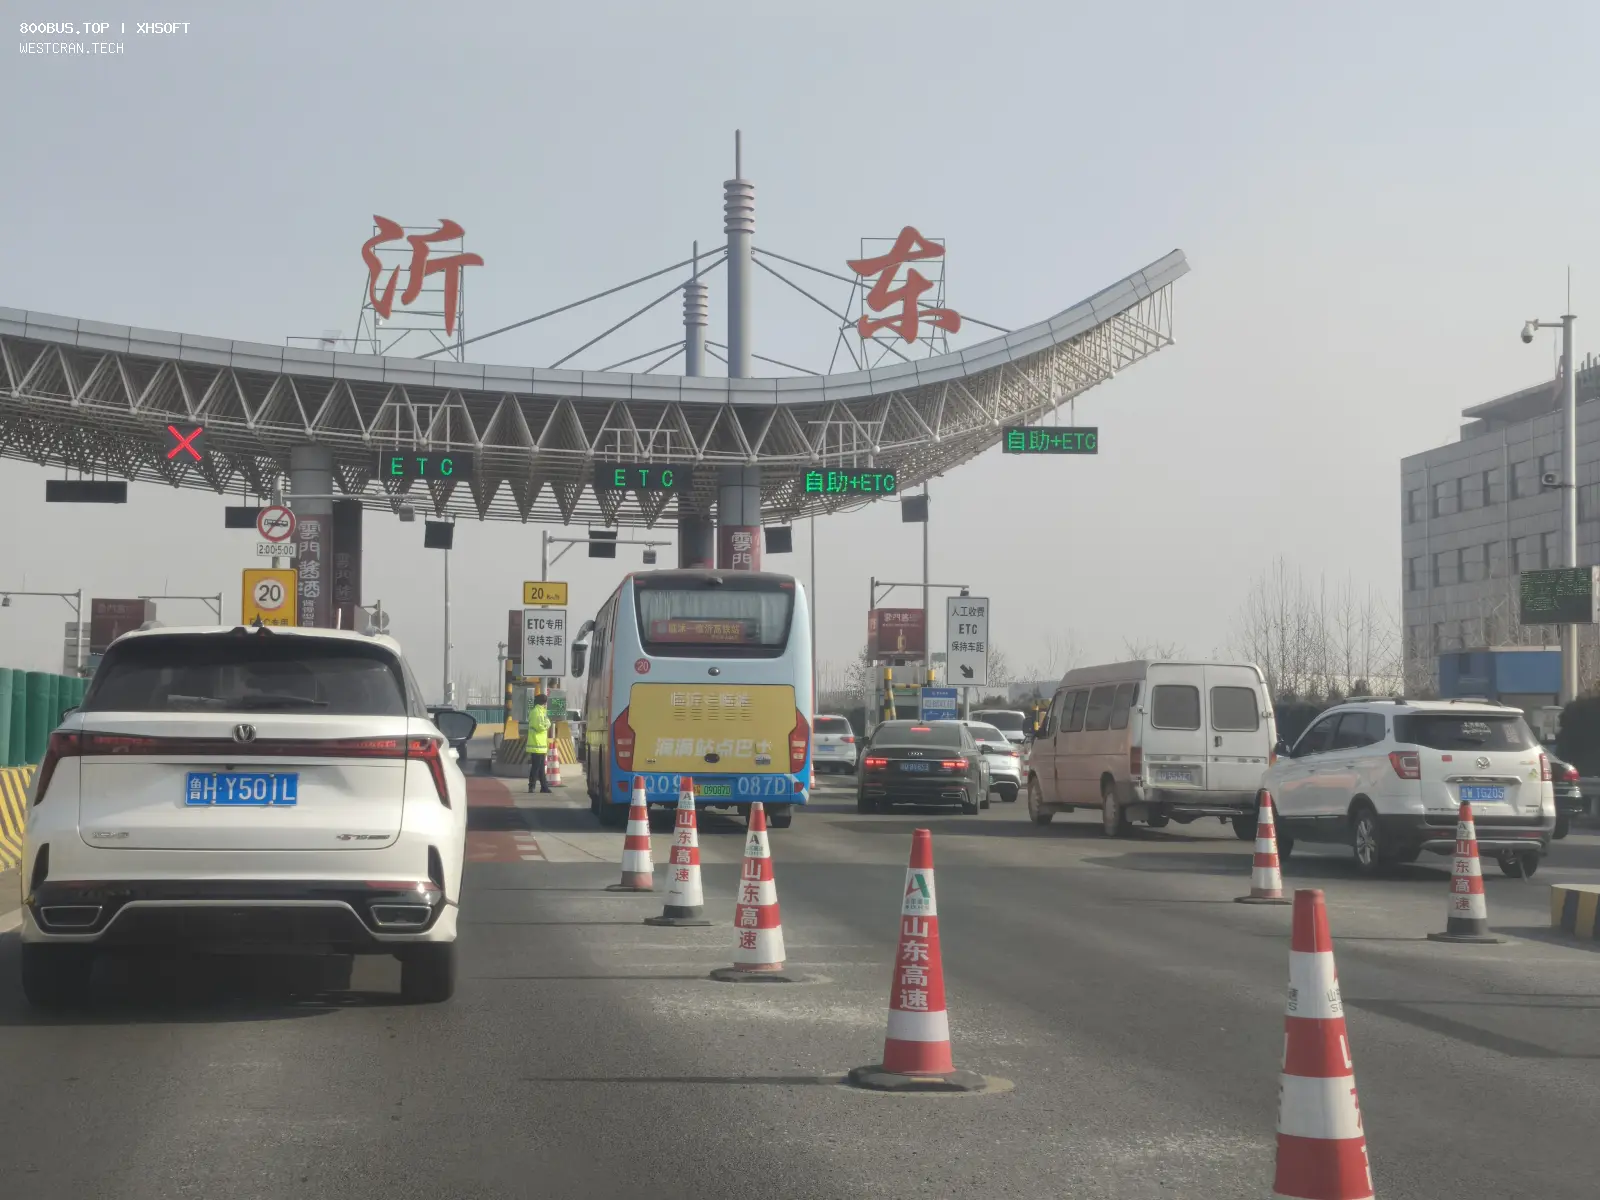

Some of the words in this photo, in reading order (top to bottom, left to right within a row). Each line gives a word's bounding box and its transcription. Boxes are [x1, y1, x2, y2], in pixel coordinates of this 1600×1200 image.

[361, 214, 485, 337] 沂
[846, 226, 961, 344] 东
[1007, 429, 1097, 451] 自助+ETC
[805, 471, 895, 493] 自助+ETC
[258, 584, 281, 602] 20
[531, 587, 544, 600] 20
[951, 606, 985, 618] 人工收费
[958, 623, 978, 635] ETC
[527, 635, 563, 647] 保持车距
[951, 641, 985, 653] 保持车距
[637, 661, 649, 672] 20
[737, 776, 786, 795] 087D
[674, 811, 694, 882] 山东高速
[1455, 842, 1472, 911] 山东高速
[738, 860, 762, 950] 山东高速
[899, 916, 929, 1011] 山东高速
